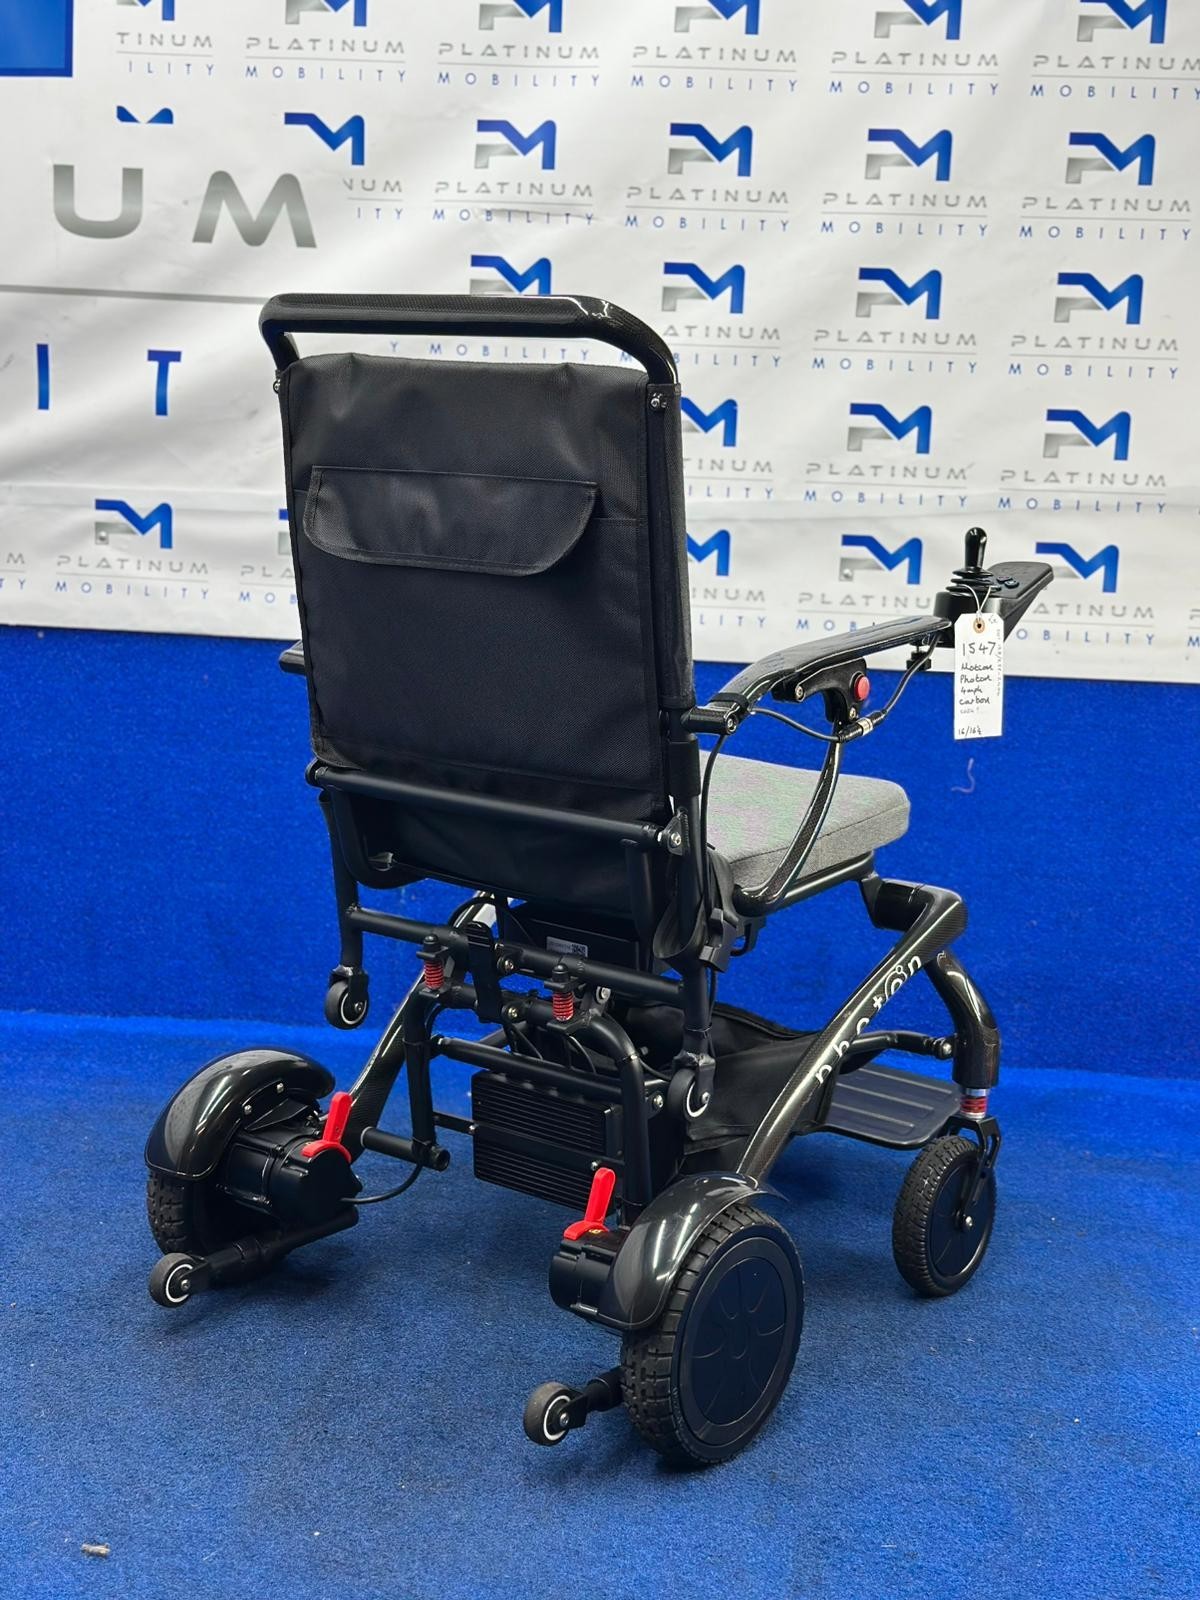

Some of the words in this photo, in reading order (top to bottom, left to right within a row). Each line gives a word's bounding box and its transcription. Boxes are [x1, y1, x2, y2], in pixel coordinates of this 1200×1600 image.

[116, 32, 213, 48] TINUM
[246, 37, 405, 54] PLATINUM
[439, 43, 600, 60] PLATINUM
[632, 46, 797, 63] PLATINUM
[831, 51, 999, 67] PLATINUM
[128, 60, 214, 76] ILITY
[1033, 55, 1200, 71] PLATINUM
[245, 65, 406, 82] MOBILITY
[437, 71, 599, 88] MOBILITY
[631, 75, 797, 92] MOBILITY
[829, 80, 999, 97] MOBILITY
[435, 181, 593, 198] PLATINUM
[626, 186, 789, 204] PLATINUM
[822, 192, 988, 209] PLATINUM
[1022, 197, 1191, 212] PLATINUM
[433, 208, 594, 225] MOBILITY
[625, 214, 790, 232] MOBILITY
[821, 221, 989, 237] MOBILITY
[1019, 225, 1192, 241] MOBILITY
[663, 325, 781, 340] ATINUM
[814, 330, 977, 347] PLATINUM
[1011, 335, 1179, 351] PLATINUM
[428, 343, 590, 361] MOBILITY
[812, 357, 978, 375] MOBILITY
[1008, 363, 1179, 380] MOBILITY
[806, 463, 967, 480] PLATINUM
[1001, 469, 1166, 487] PLATINUM
[688, 485, 774, 500] ILITY
[803, 489, 969, 507] MOBILITY
[998, 496, 1167, 514] MOBILITY
[57, 555, 208, 574] PLATINUM
[55, 581, 209, 599] MOBILITY
[798, 592, 931, 609] PLATINU
[1033, 602, 1154, 618] ATINUM
[1016, 628, 1155, 645] OBILITY
[962, 641, 996, 656] 1547
